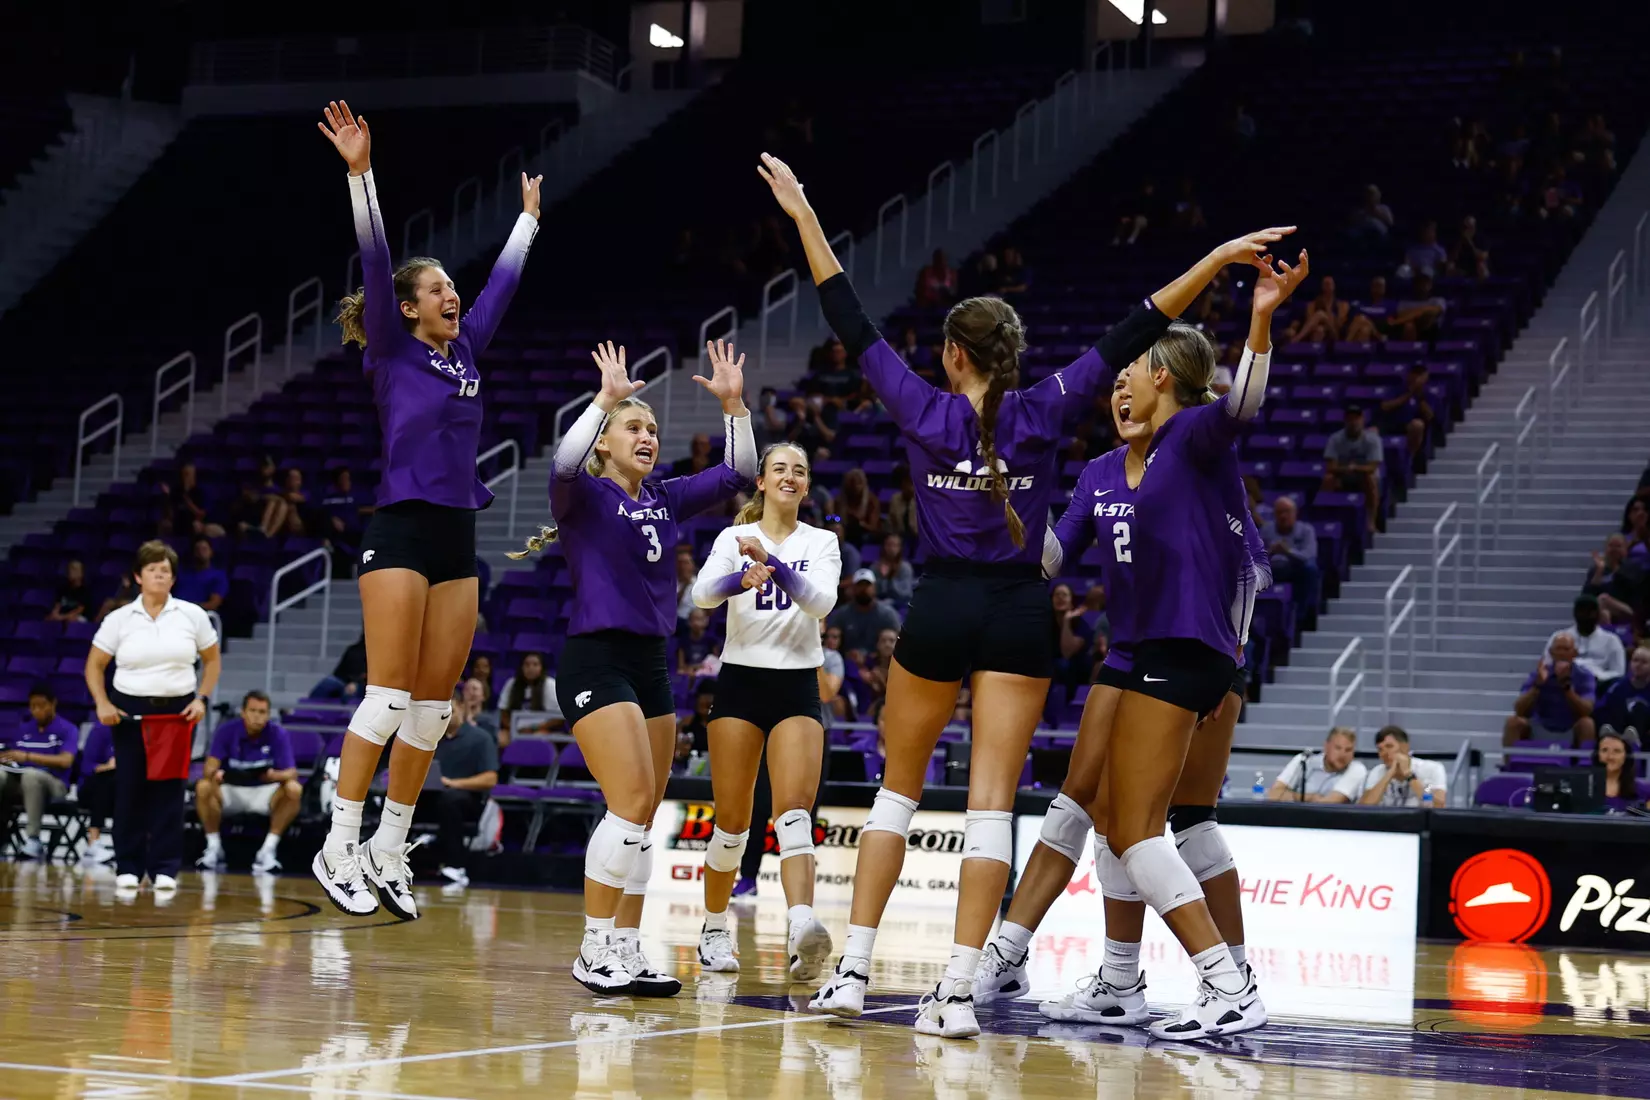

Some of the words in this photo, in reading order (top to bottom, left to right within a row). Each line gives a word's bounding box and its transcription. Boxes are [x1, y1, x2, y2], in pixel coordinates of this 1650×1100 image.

[927, 473, 1034, 491] WILDCTS
[641, 524, 662, 562] 3
[1112, 521, 1133, 563] 2
[927, 878, 960, 890] GRA
[1560, 874, 1650, 933] Piz
